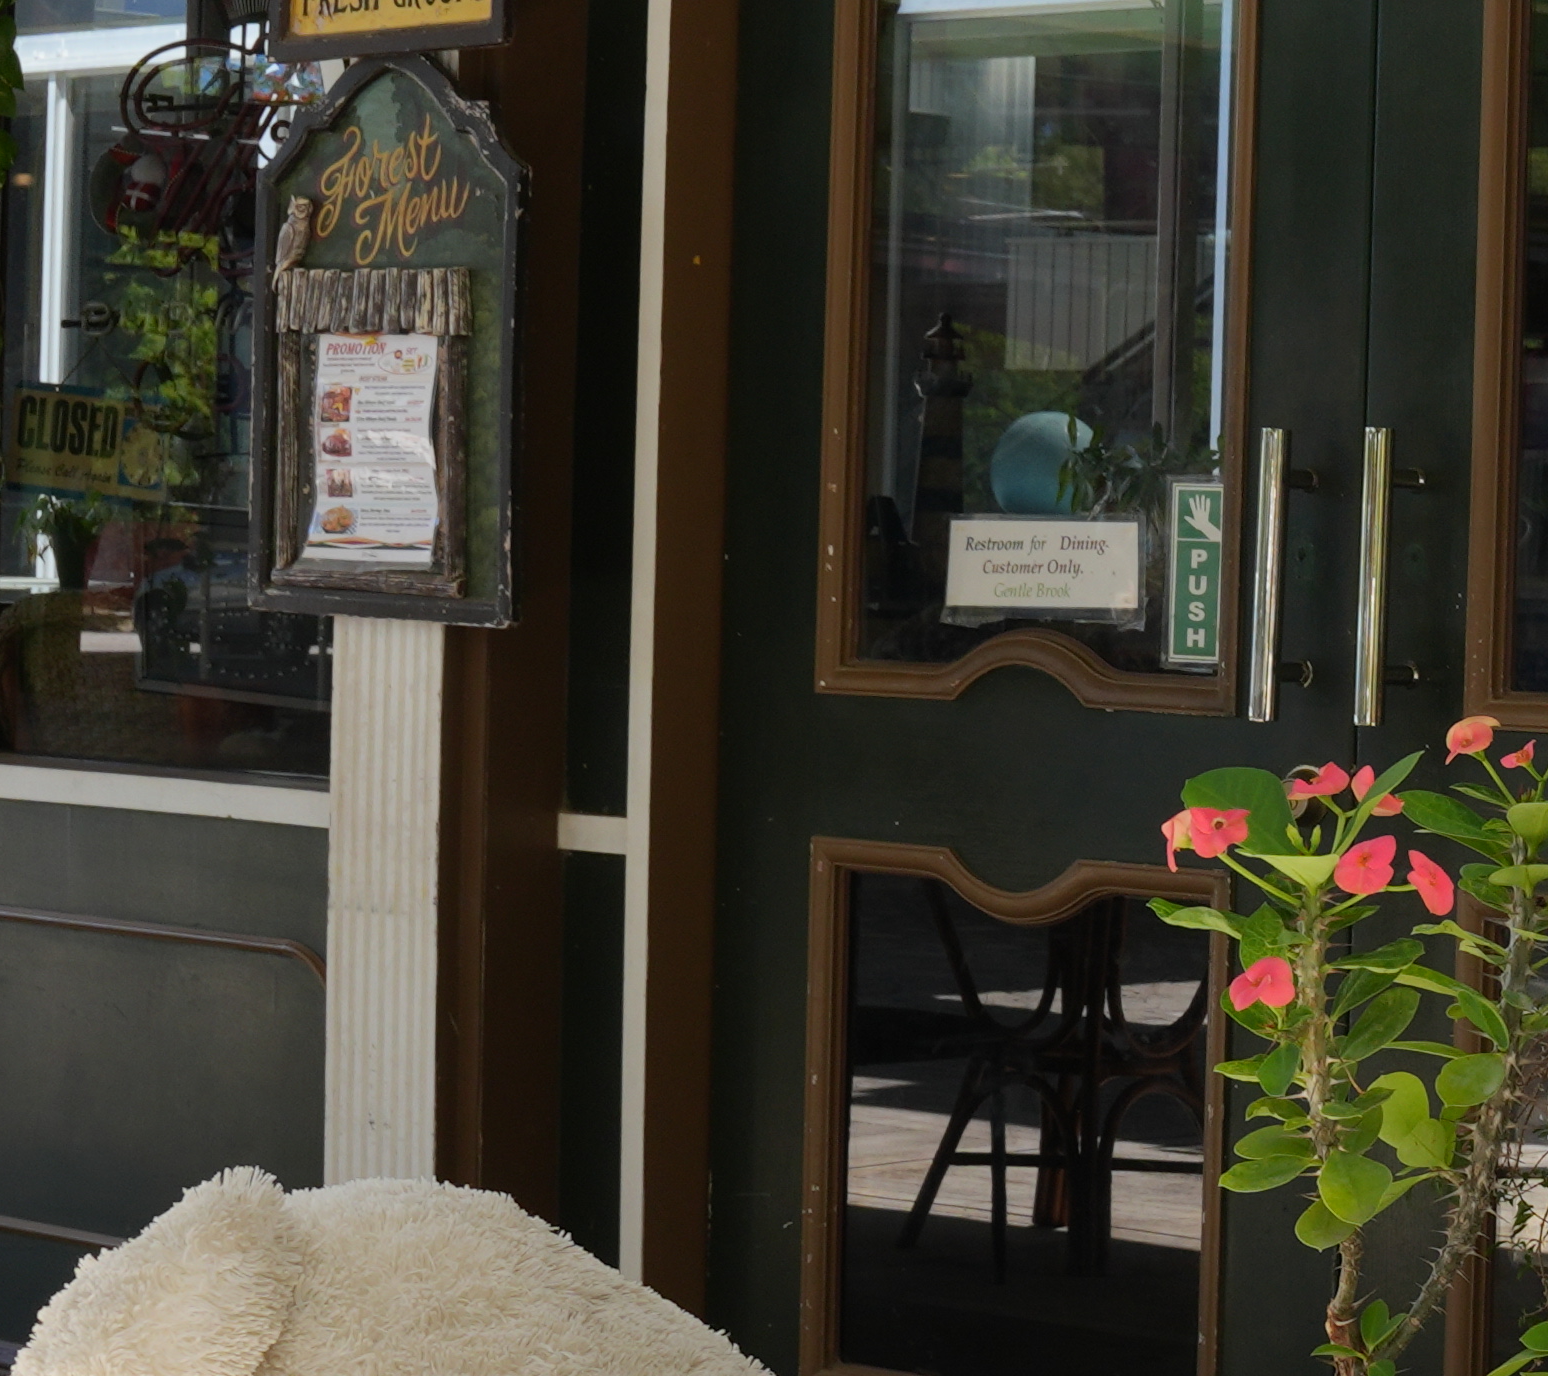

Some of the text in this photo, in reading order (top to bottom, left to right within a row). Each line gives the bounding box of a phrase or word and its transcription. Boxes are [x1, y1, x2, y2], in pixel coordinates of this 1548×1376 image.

[317, 111, 442, 238] Forest
[354, 175, 471, 266] Menu
[326, 342, 388, 356] PROMOTION
[18, 395, 119, 458] CLOSED
[965, 536, 1024, 552] Restroom
[1027, 535, 1047, 556] for
[983, 559, 1084, 580] Customer Only.
[994, 582, 1071, 598] Gentle Brook
[1186, 548, 1209, 648] PUSH
